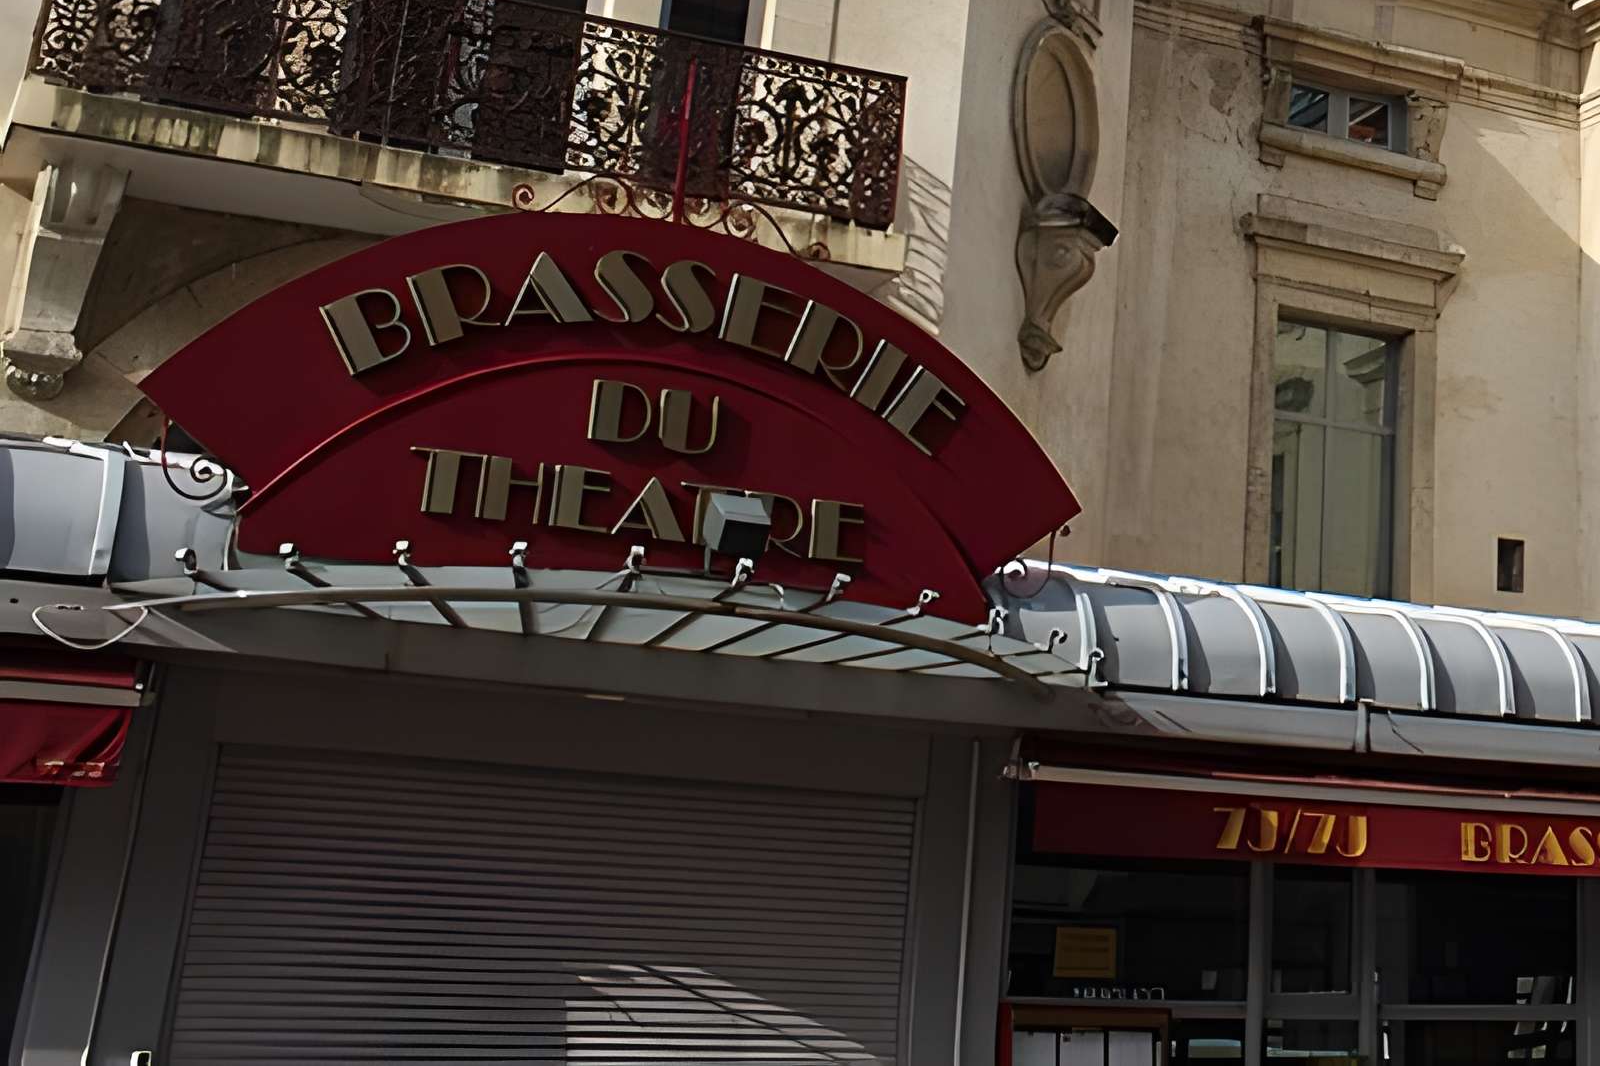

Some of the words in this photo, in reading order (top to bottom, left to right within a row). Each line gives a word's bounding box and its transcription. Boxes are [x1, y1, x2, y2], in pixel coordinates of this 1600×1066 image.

[320, 250, 965, 455] BRASSERIE
[588, 379, 719, 454] DU
[1213, 808, 1367, 857] 7J/7J
